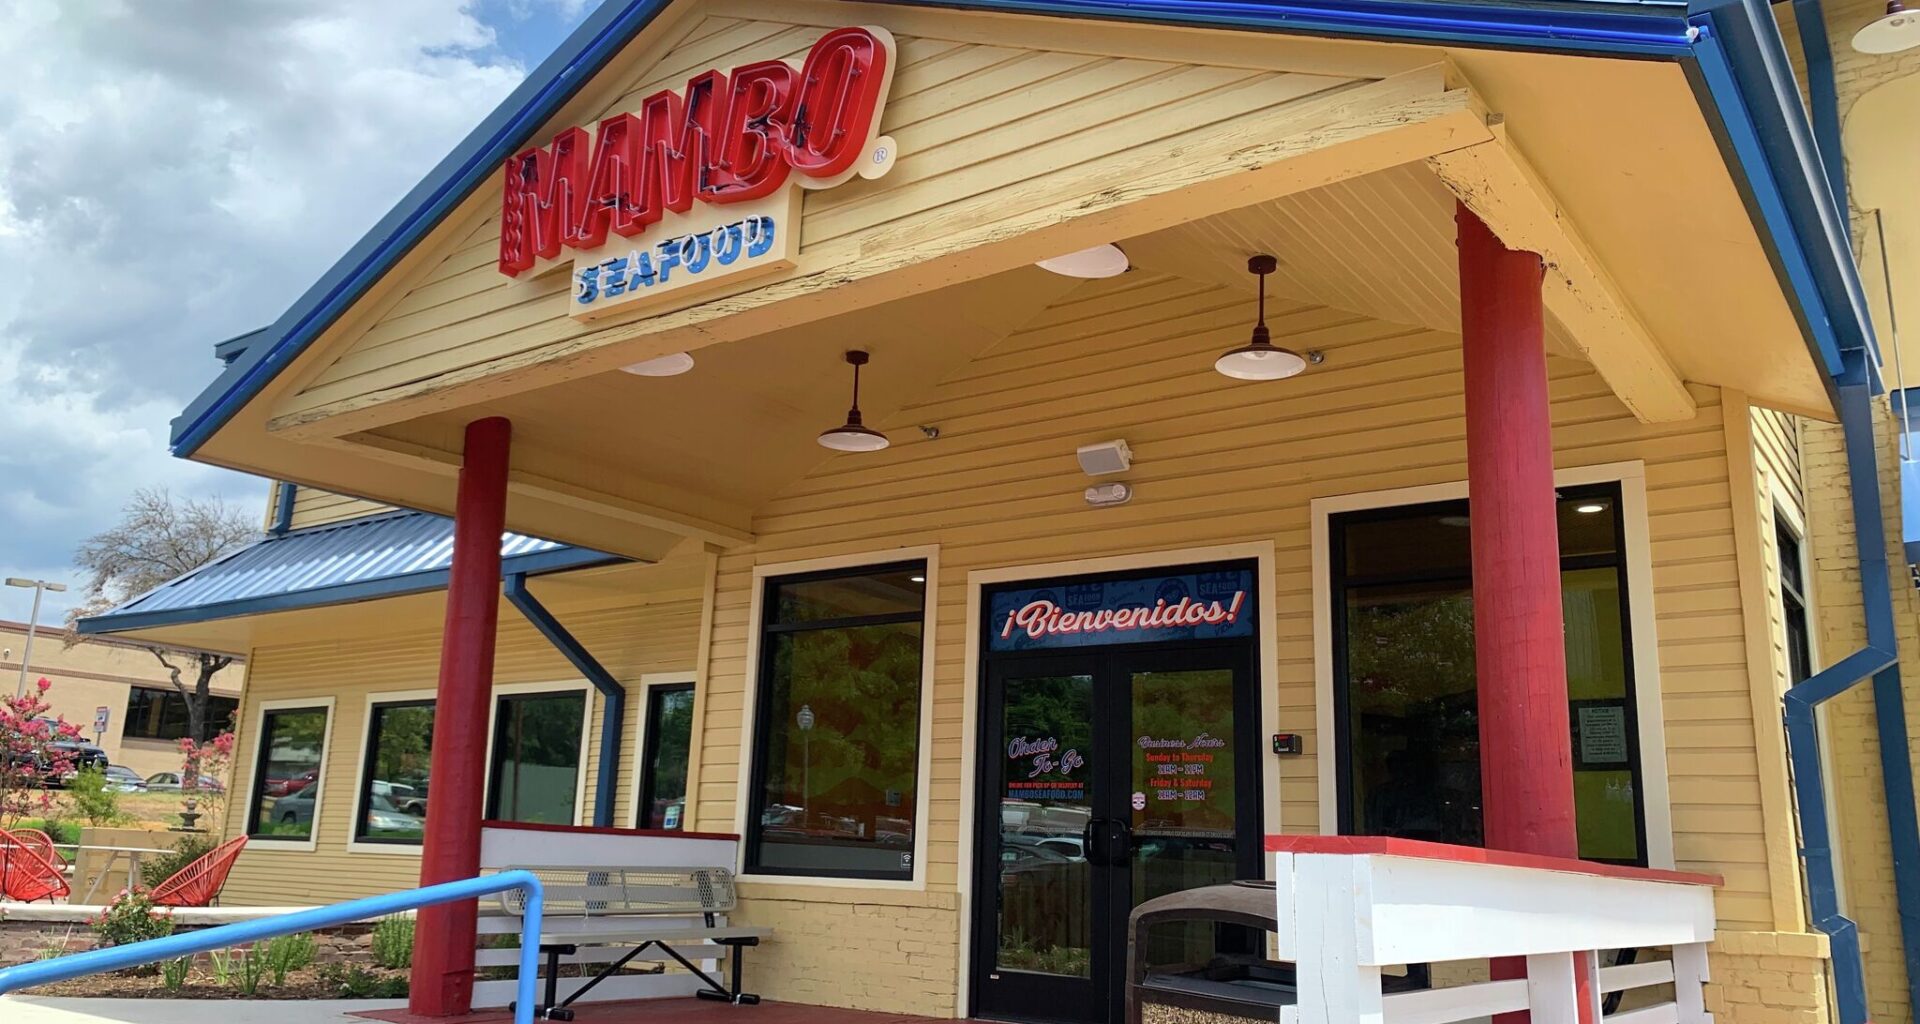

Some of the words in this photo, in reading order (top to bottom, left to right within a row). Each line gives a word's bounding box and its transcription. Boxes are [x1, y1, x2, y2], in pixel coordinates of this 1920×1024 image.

[498, 27, 887, 277] MAMBO
[574, 214, 775, 304] SEAFOOD
[1001, 590, 1246, 640] ¡Bienvenidos!
[1008, 736, 1058, 758] Order
[1137, 735, 1186, 749] Business
[1186, 732, 1225, 749] Hours
[1146, 753, 1170, 762] Sunday
[1172, 753, 1180, 761] to
[1182, 752, 1213, 763] Thursday
[1150, 778, 1171, 788] Friday
[1180, 778, 1212, 789] Saturday
[1008, 789, 1084, 800] MAMBOSEAFOOD.COM
